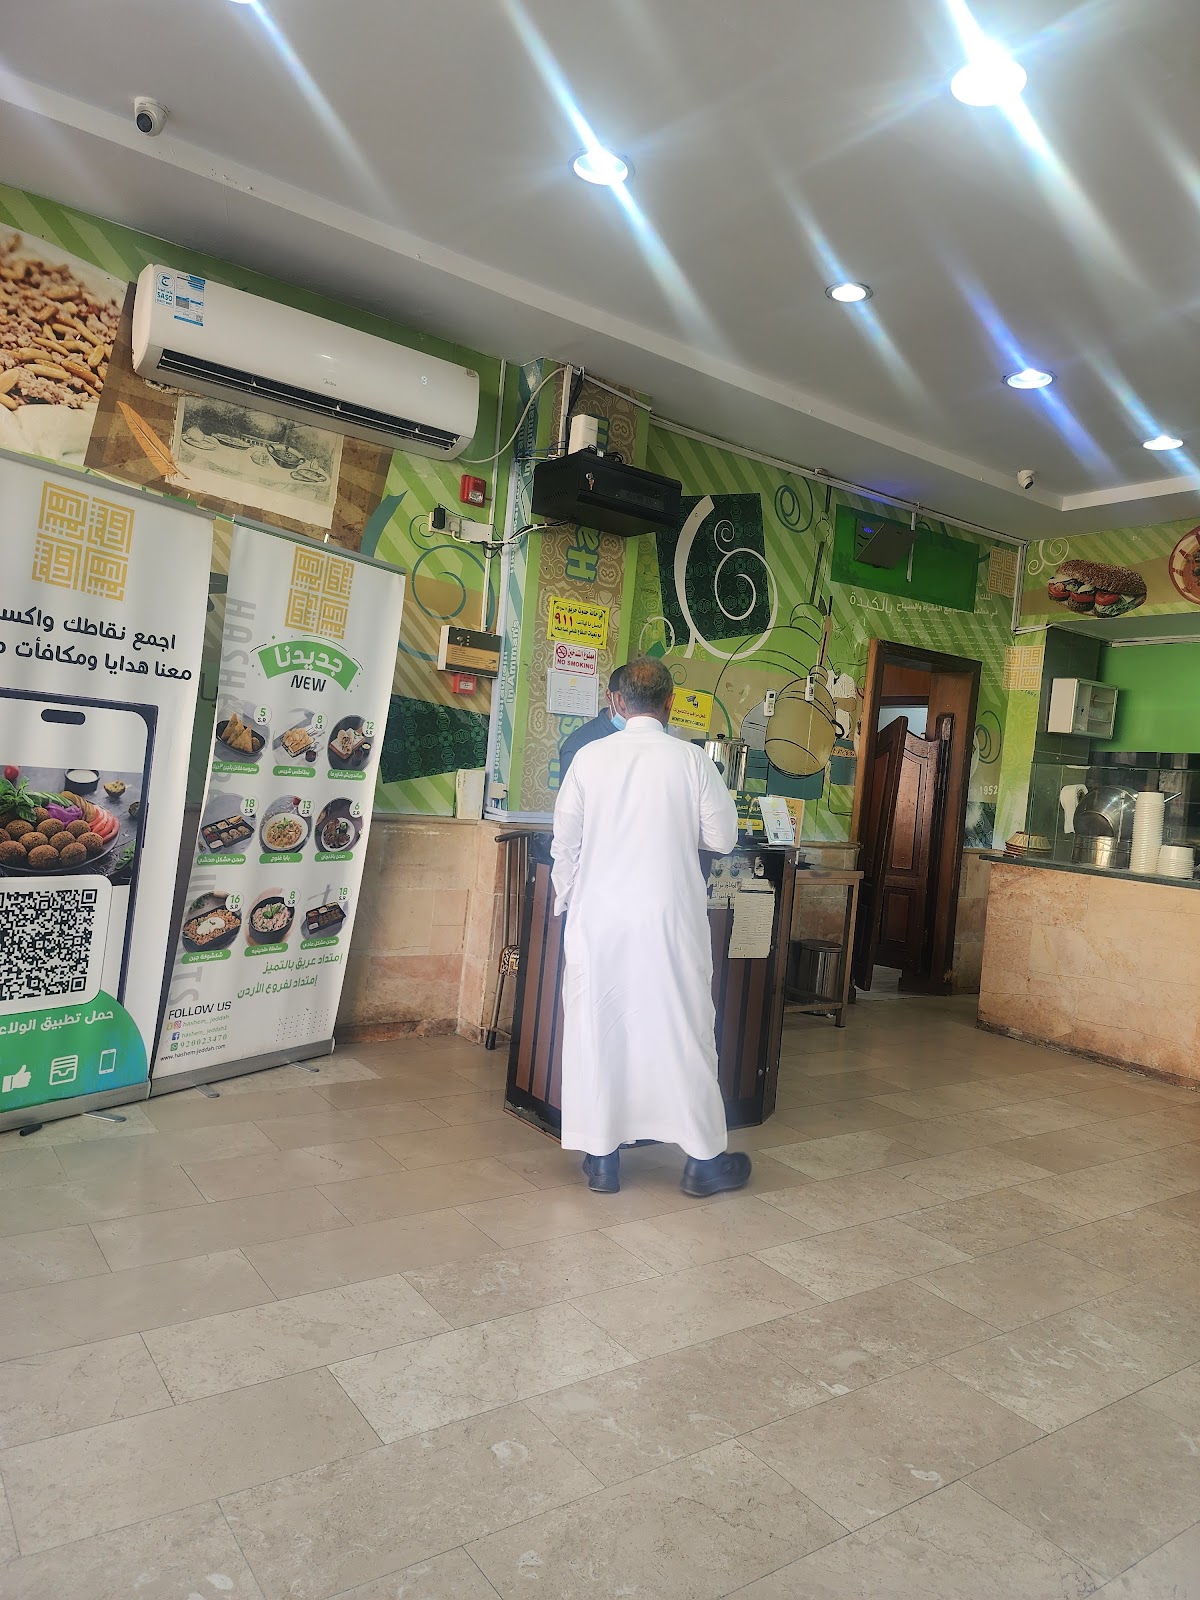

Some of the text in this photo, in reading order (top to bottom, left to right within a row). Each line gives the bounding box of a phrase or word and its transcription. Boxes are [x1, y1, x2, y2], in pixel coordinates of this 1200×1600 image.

[850, 591, 893, 617] بالكبدة
[0, 606, 176, 652] اجمع نقاطك واكس
[15, 636, 98, 671] ومكافأت
[583, 651, 595, 661] ممنوع
[104, 653, 149, 675] هدايا
[274, 645, 343, 677] جديدنا
[567, 660, 594, 670] SMOKING
[154, 661, 192, 681] معنا
[290, 674, 327, 692] NEW
[259, 707, 266, 717] 5
[316, 714, 323, 724] 8
[366, 721, 375, 730] 12
[244, 798, 255, 808] 18
[302, 800, 312, 809] 13
[354, 801, 360, 810] 6
[289, 890, 296, 900] 8
[339, 887, 348, 896] 18
[230, 894, 241, 904] 16
[262, 959, 295, 974] بالتميز
[295, 957, 316, 970] عريق
[168, 1000, 232, 1020] FOLLOW US
[40, 1012, 82, 1031] تطبيق
[84, 1010, 114, 1025] حمل
